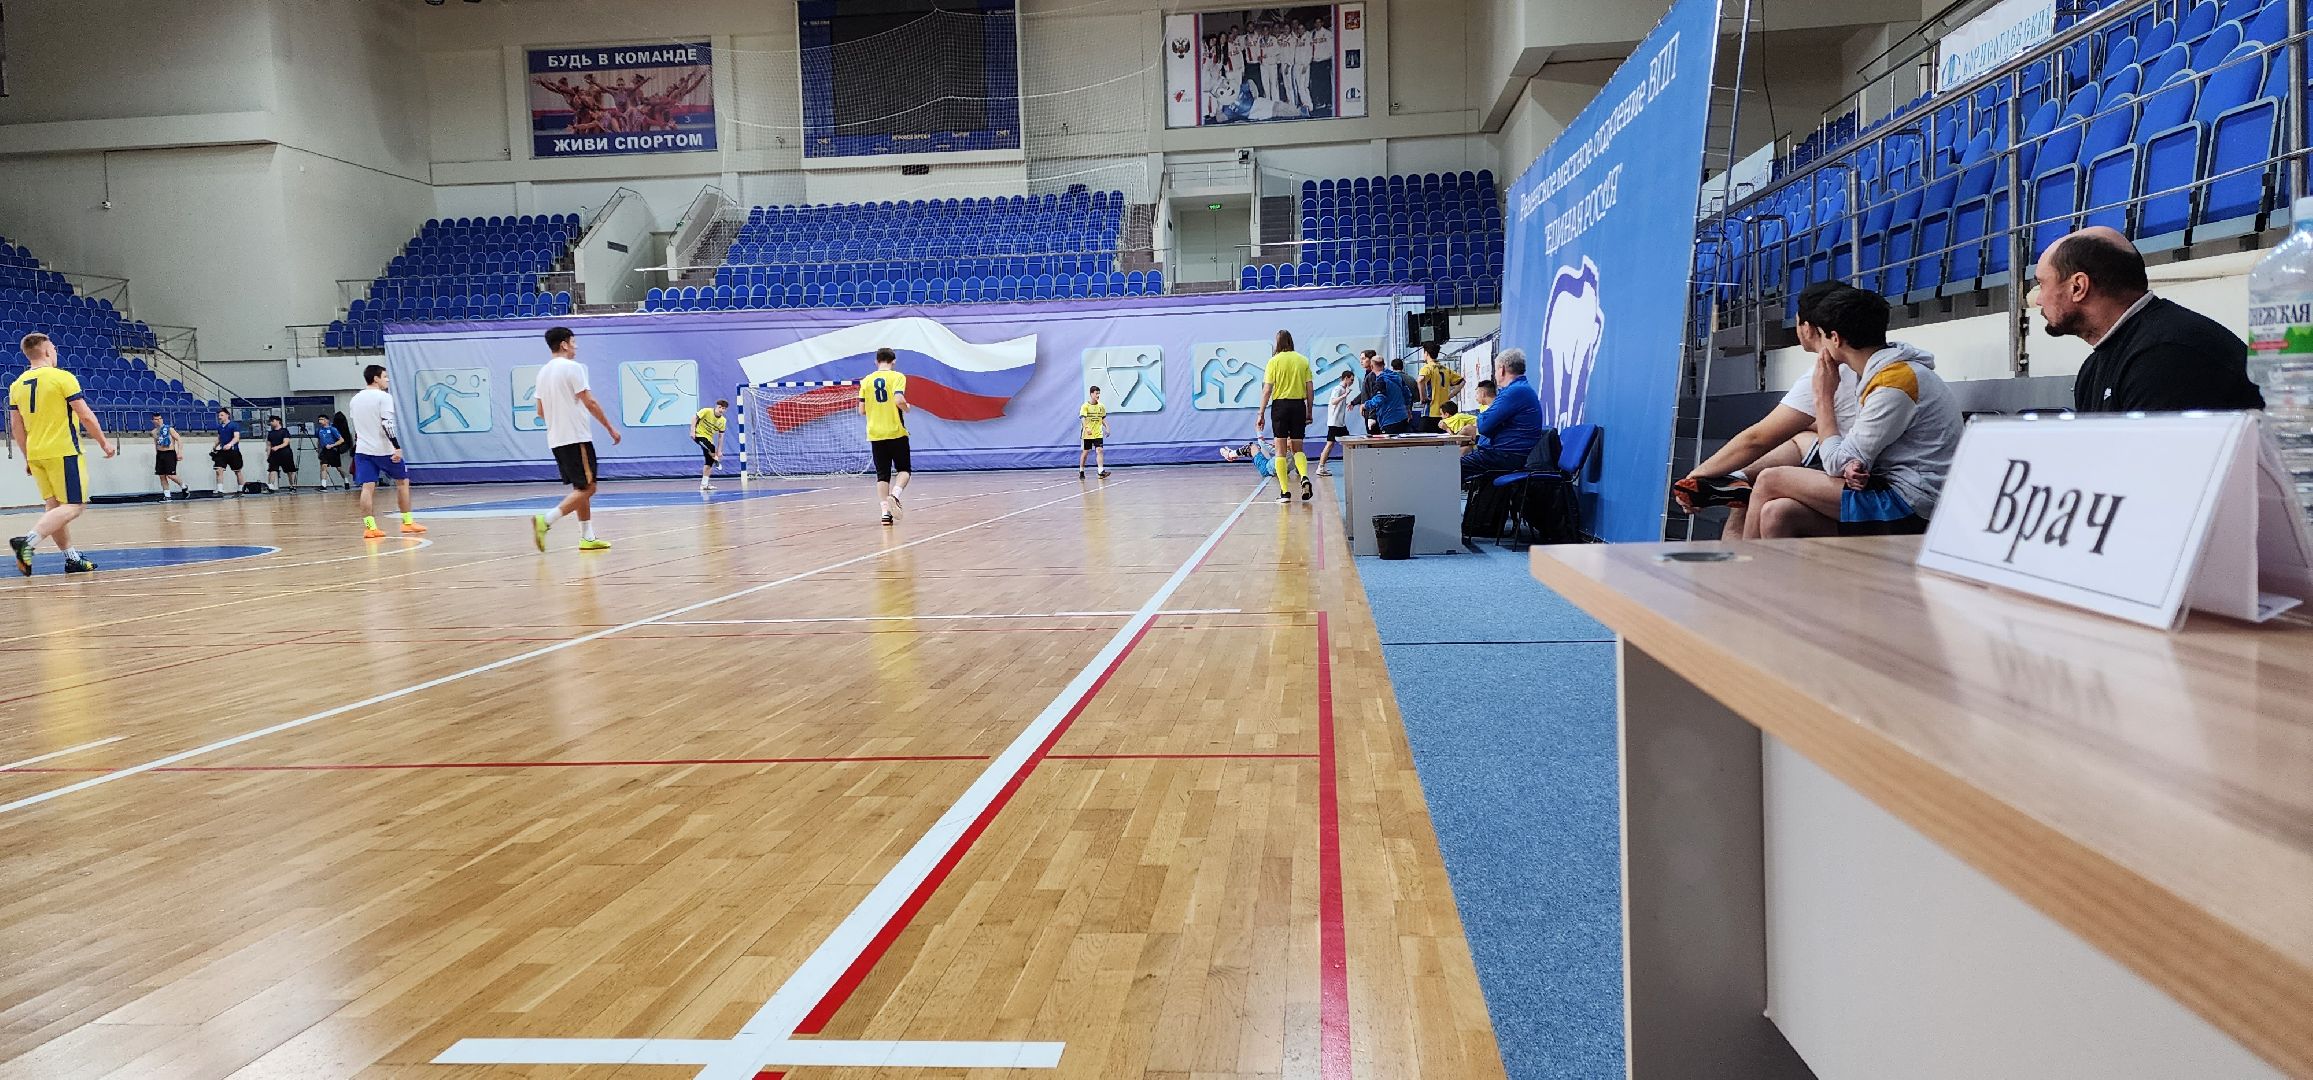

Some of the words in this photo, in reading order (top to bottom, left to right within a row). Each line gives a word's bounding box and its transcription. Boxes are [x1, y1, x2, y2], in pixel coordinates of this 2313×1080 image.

[548, 54, 592, 69] БУДЬ
[598, 53, 609, 65] В
[615, 48, 697, 65] КОМАНДЕ
[1556, 139, 1593, 190] местное
[1593, 79, 1646, 158] отделение
[1648, 30, 1680, 103] ВПП
[554, 137, 608, 152] ЖИВИ
[615, 133, 703, 150] СПОРТОМ
[23, 378, 38, 413] 7
[873, 378, 888, 403] 8
[1983, 458, 2127, 564] Врач
